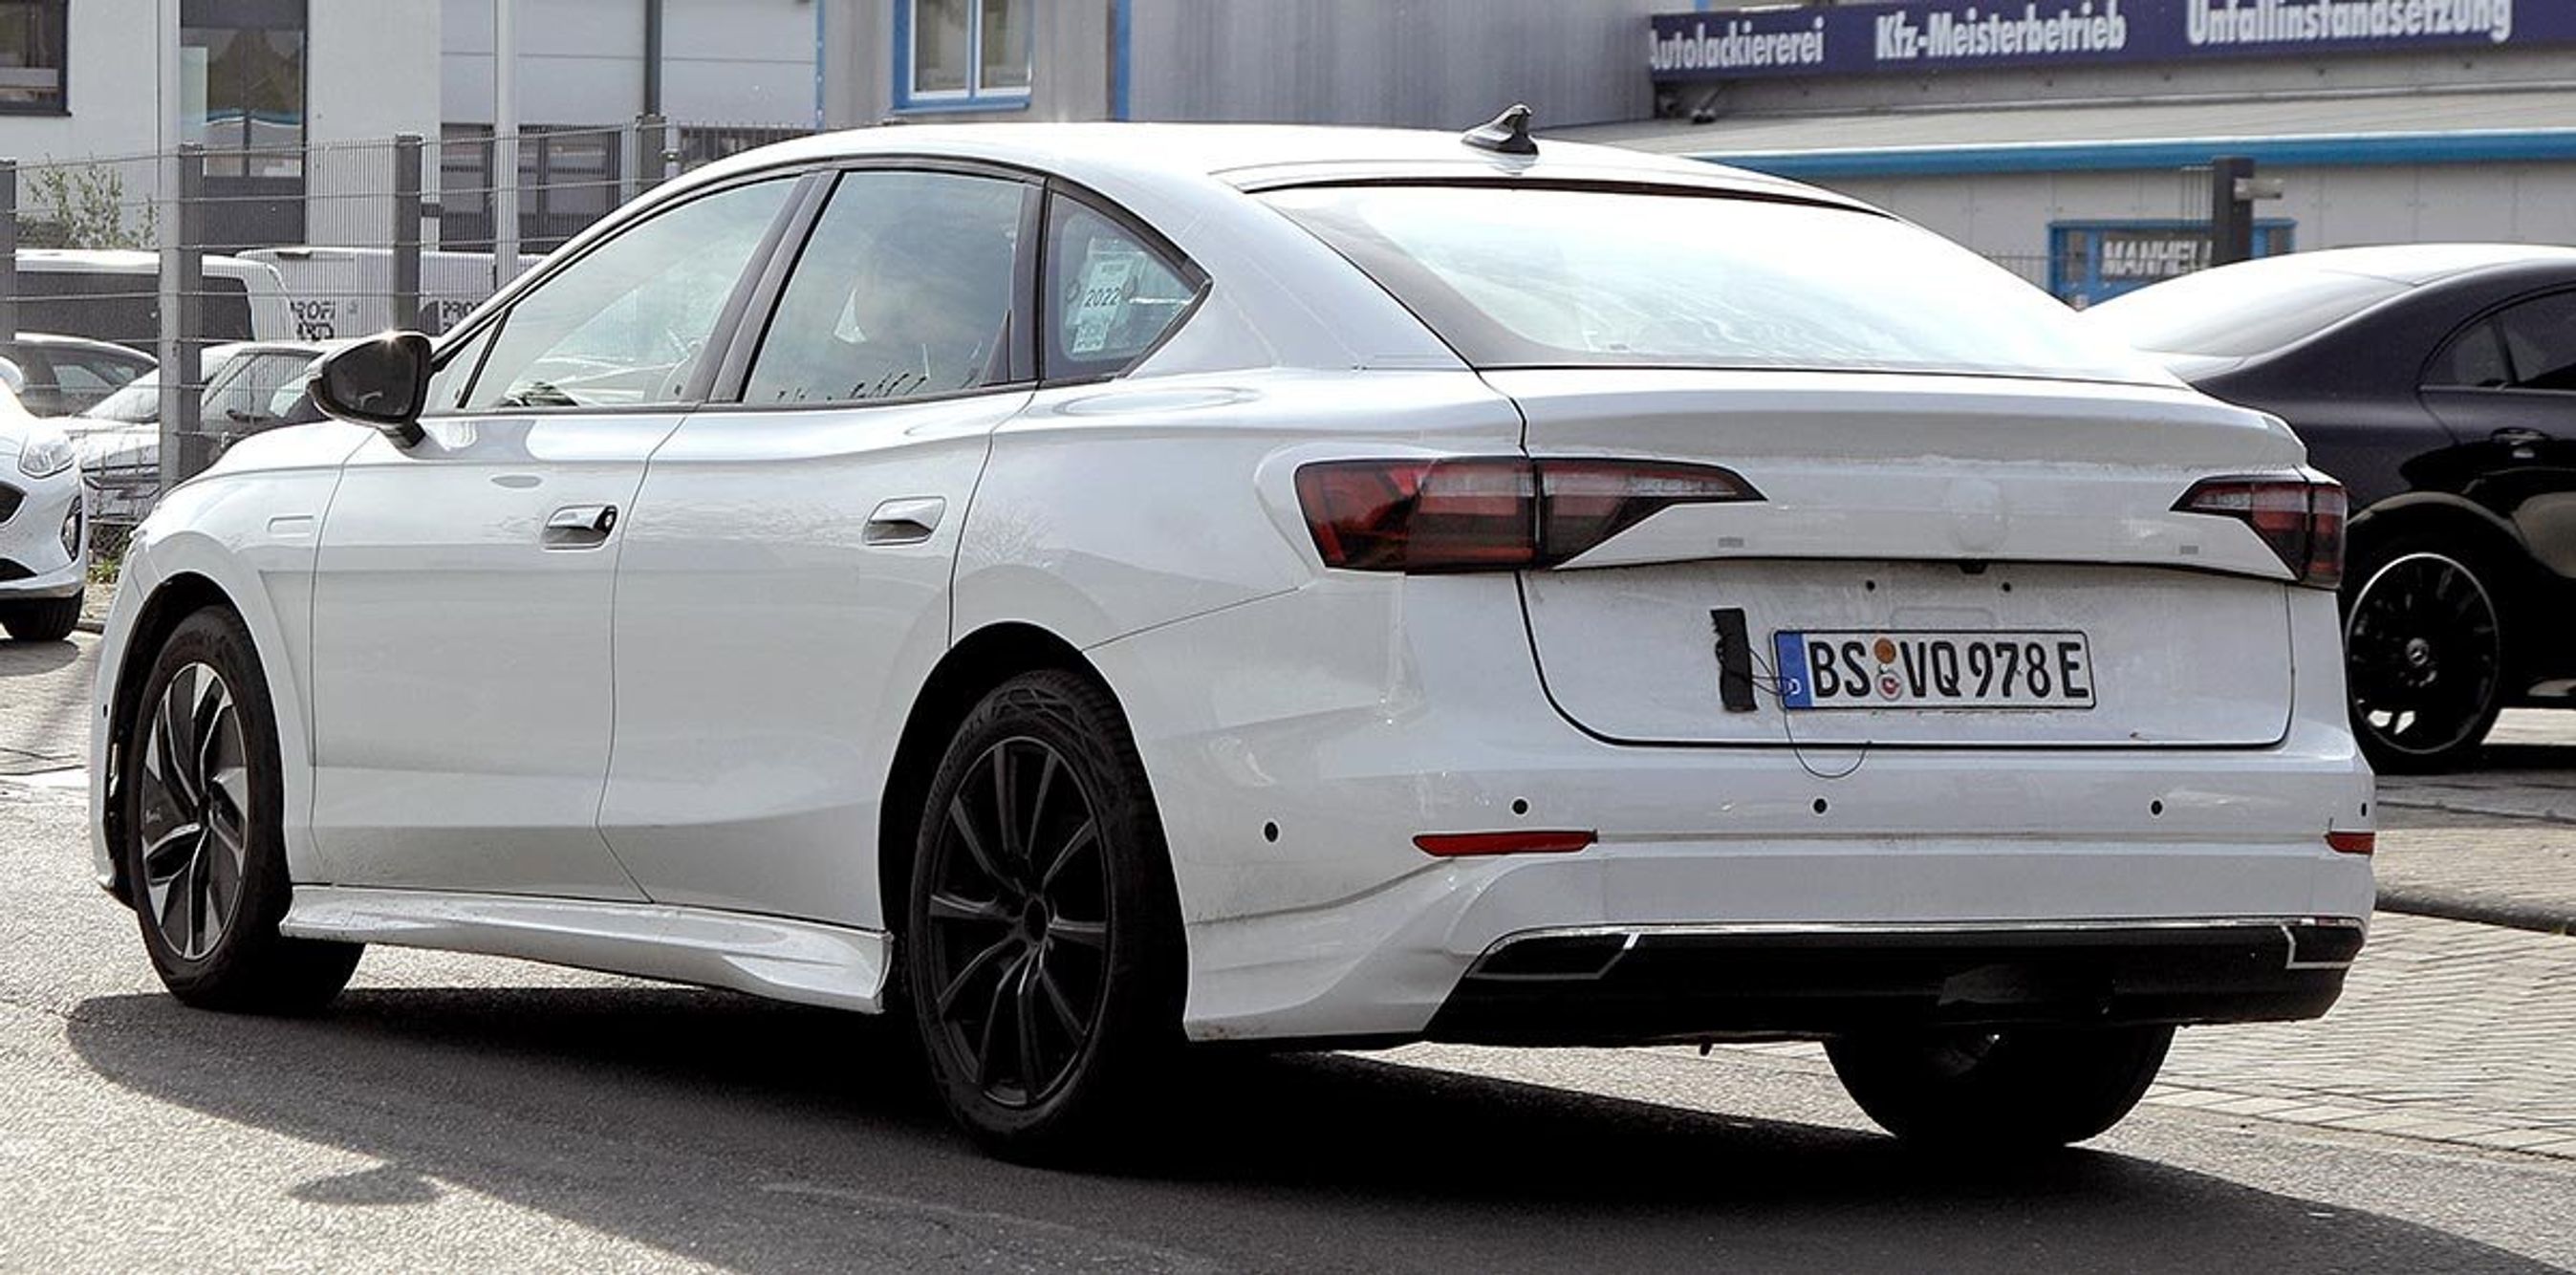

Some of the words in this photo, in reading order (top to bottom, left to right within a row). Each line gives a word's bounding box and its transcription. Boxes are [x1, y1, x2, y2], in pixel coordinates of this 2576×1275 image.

[1649, 15, 1824, 70] Autolackiererei
[1876, 0, 2127, 59] Kfz-Meisterbetrieb
[2188, 0, 2512, 43] Unfallinstandsetzung
[1084, 286, 1121, 308] 2022
[1809, 640, 1872, 698] BS
[1899, 640, 1962, 699] VQ
